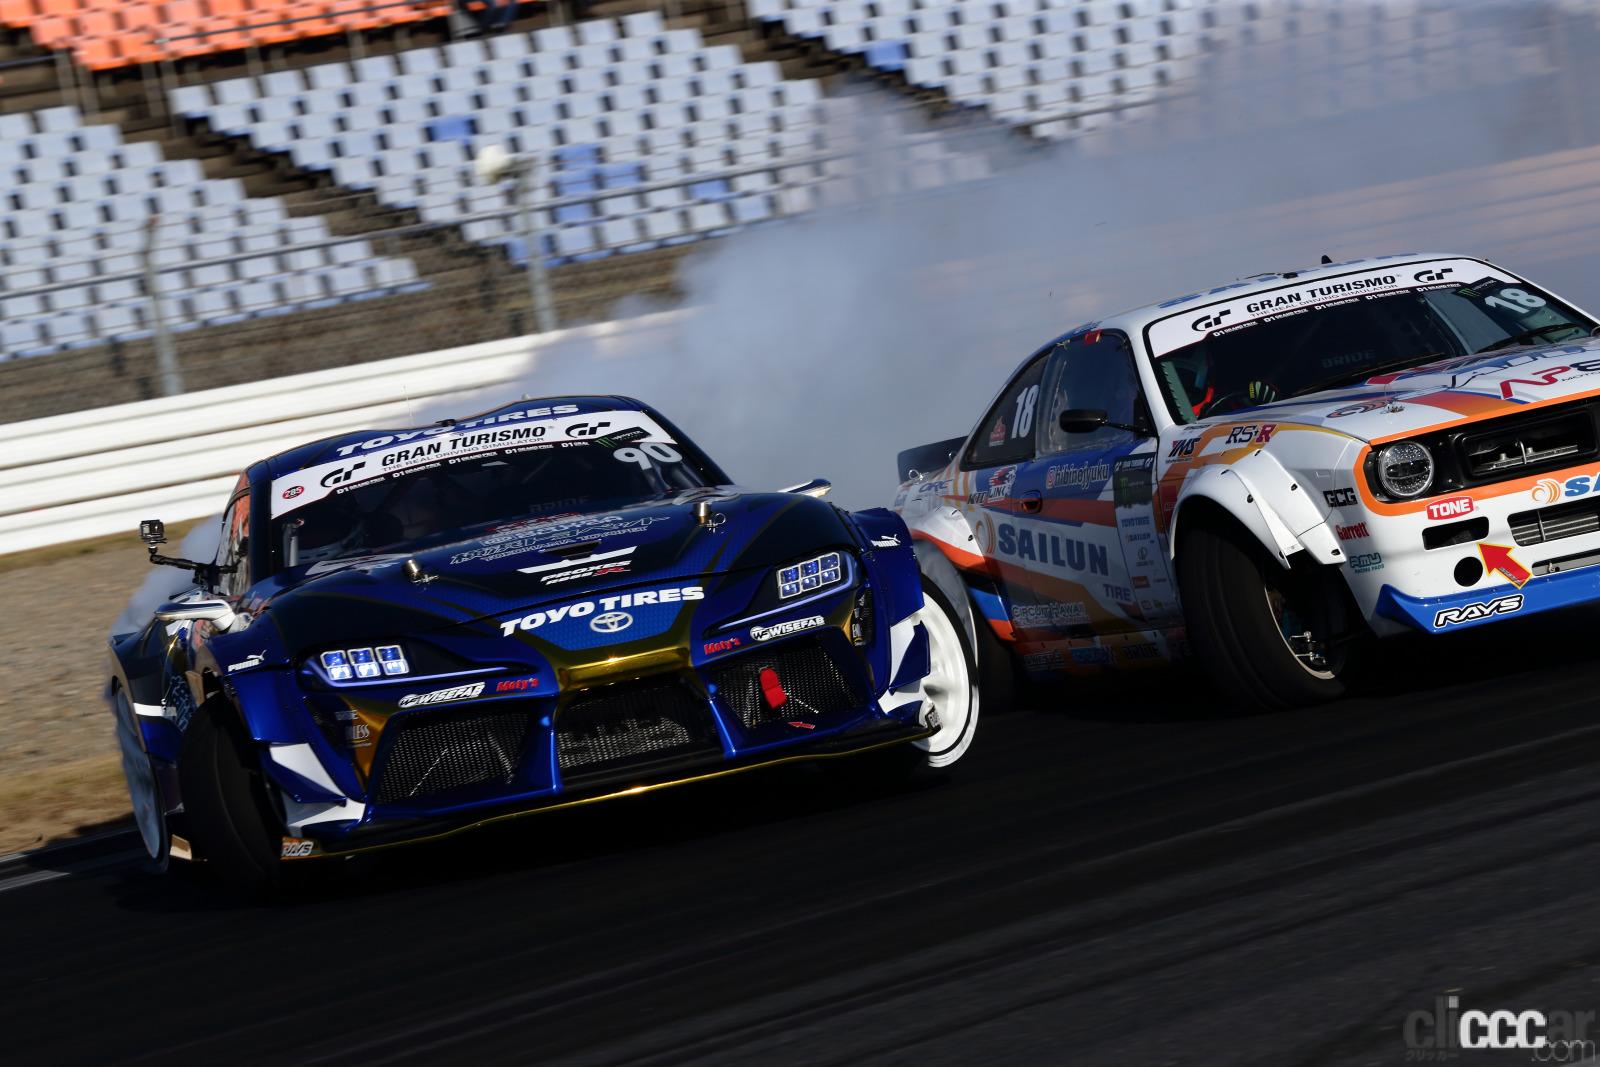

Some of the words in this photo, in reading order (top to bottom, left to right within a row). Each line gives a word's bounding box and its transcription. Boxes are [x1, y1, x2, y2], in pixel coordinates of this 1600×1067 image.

[1246, 292, 1301, 313] GRAN
[1306, 276, 1396, 298] TURISMO
[1484, 288, 1546, 314] 18
[1012, 384, 1039, 439] 18
[336, 424, 455, 458] TOYO
[461, 404, 580, 428] TIRES
[382, 441, 441, 468] GRAN
[449, 426, 546, 450] TURISMO
[613, 442, 683, 470] 90
[1565, 472, 1600, 497] S
[1323, 488, 1358, 507] GCG
[1429, 498, 1470, 518] TONE
[1336, 522, 1370, 541] Garrett
[998, 524, 1109, 576] SAILUN
[1103, 583, 1132, 601] TIRE
[500, 601, 595, 637] TOYO
[599, 586, 704, 610] TIRES
[1434, 595, 1524, 628] RAYS
[769, 615, 825, 635] WISEFAB
[704, 637, 742, 655] Moty's
[418, 682, 486, 705] WISEFAB
[496, 677, 538, 692] Moty's
